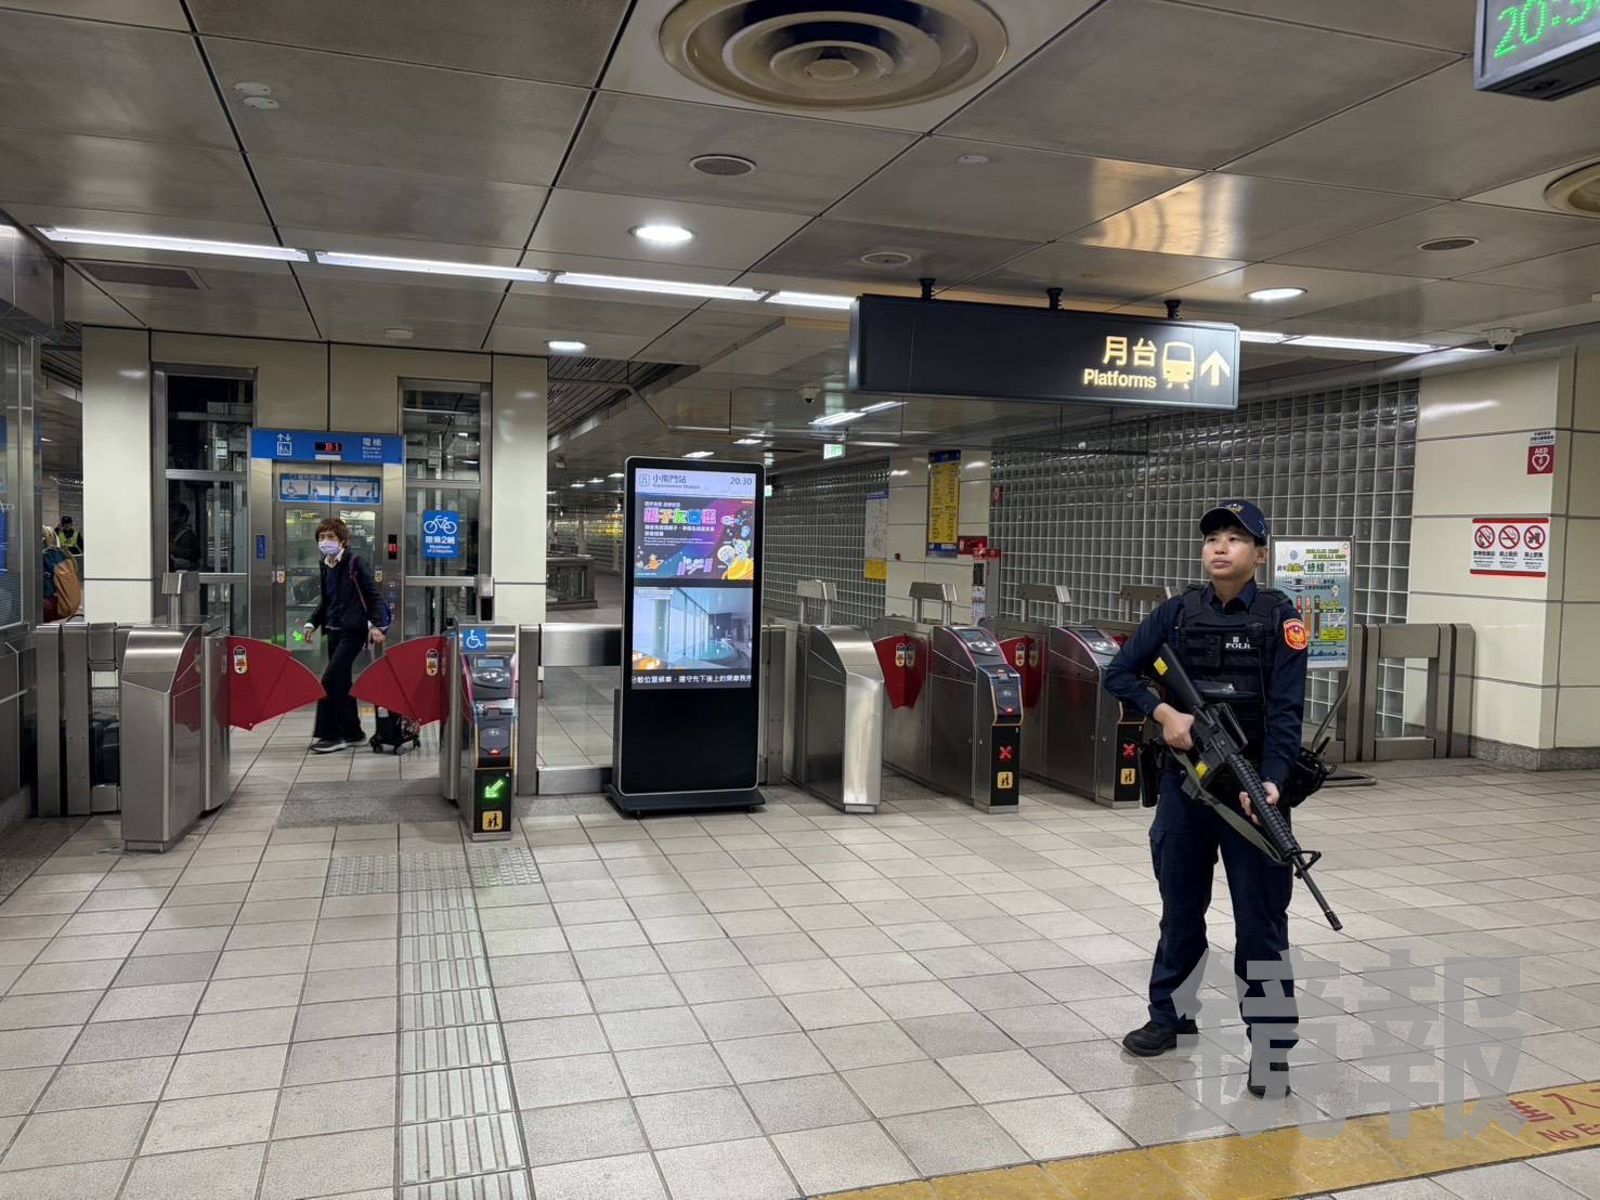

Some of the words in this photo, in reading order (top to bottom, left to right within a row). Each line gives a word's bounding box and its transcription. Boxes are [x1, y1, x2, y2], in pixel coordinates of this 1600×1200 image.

[1494, 0, 1600, 57] 20:3
[1103, 336, 1157, 367] 月台
[1083, 368, 1157, 388] Platforms
[730, 476, 752, 485] 20:30
